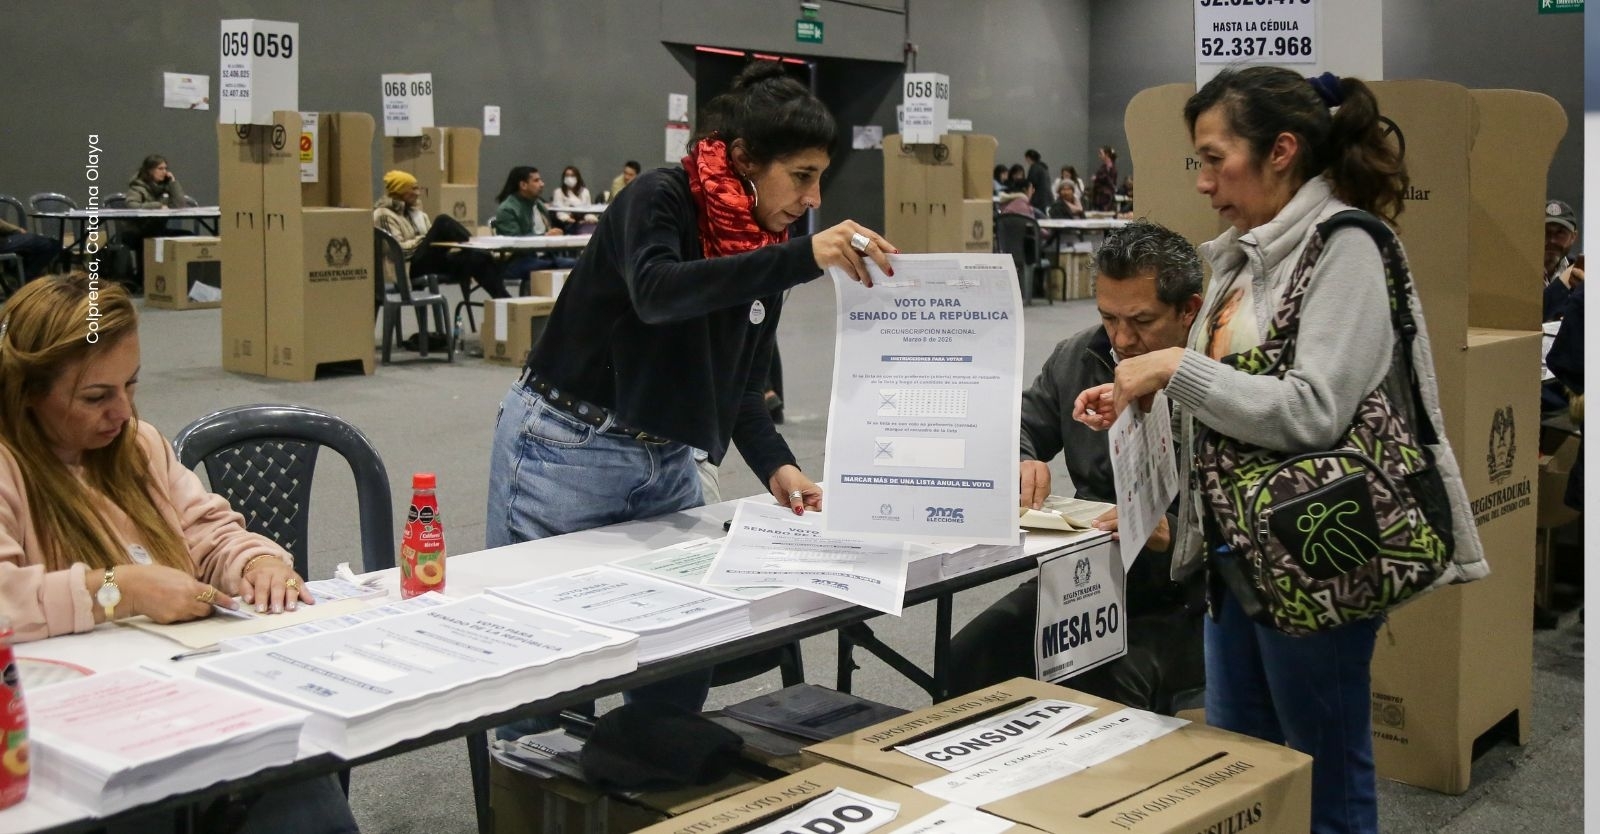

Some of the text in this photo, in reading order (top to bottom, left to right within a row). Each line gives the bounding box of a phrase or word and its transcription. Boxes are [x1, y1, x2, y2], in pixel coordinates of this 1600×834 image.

[1213, 19, 1299, 32] HASTA LA CÉDULA
[222, 31, 249, 57] 059
[253, 32, 293, 59] 059
[1202, 36, 1312, 56] 52.337.968
[385, 82, 407, 97] 068
[411, 80, 432, 96] 068
[906, 81, 932, 98] 058
[935, 82, 949, 100] 058
[894, 298, 962, 308] VOTO PARA
[850, 309, 1009, 321] SENADO DE LA REPÚBLICA
[873, 476, 888, 484] MÁS
[1470, 476, 1530, 516] REGISTRADURÍA
[1500, 502, 1518, 516] ESTADO
[1518, 497, 1530, 508] CIVIL
[744, 526, 790, 536] SENADO
[1042, 602, 1118, 659] MESA 50
[862, 718, 928, 744] DEPOSITE
[928, 713, 949, 722] SU
[947, 700, 982, 714] VOTO
[925, 705, 1072, 762] CONSULTA
[965, 768, 998, 780] URNA
[1004, 747, 1054, 767] CERRADA
[1074, 722, 1120, 740] SELLADA
[1192, 760, 1255, 790] DEPOSITE
[1176, 784, 1201, 798] SU
[712, 810, 740, 823] SU
[739, 796, 782, 813] VOTO
[1143, 794, 1184, 813] VOTO
